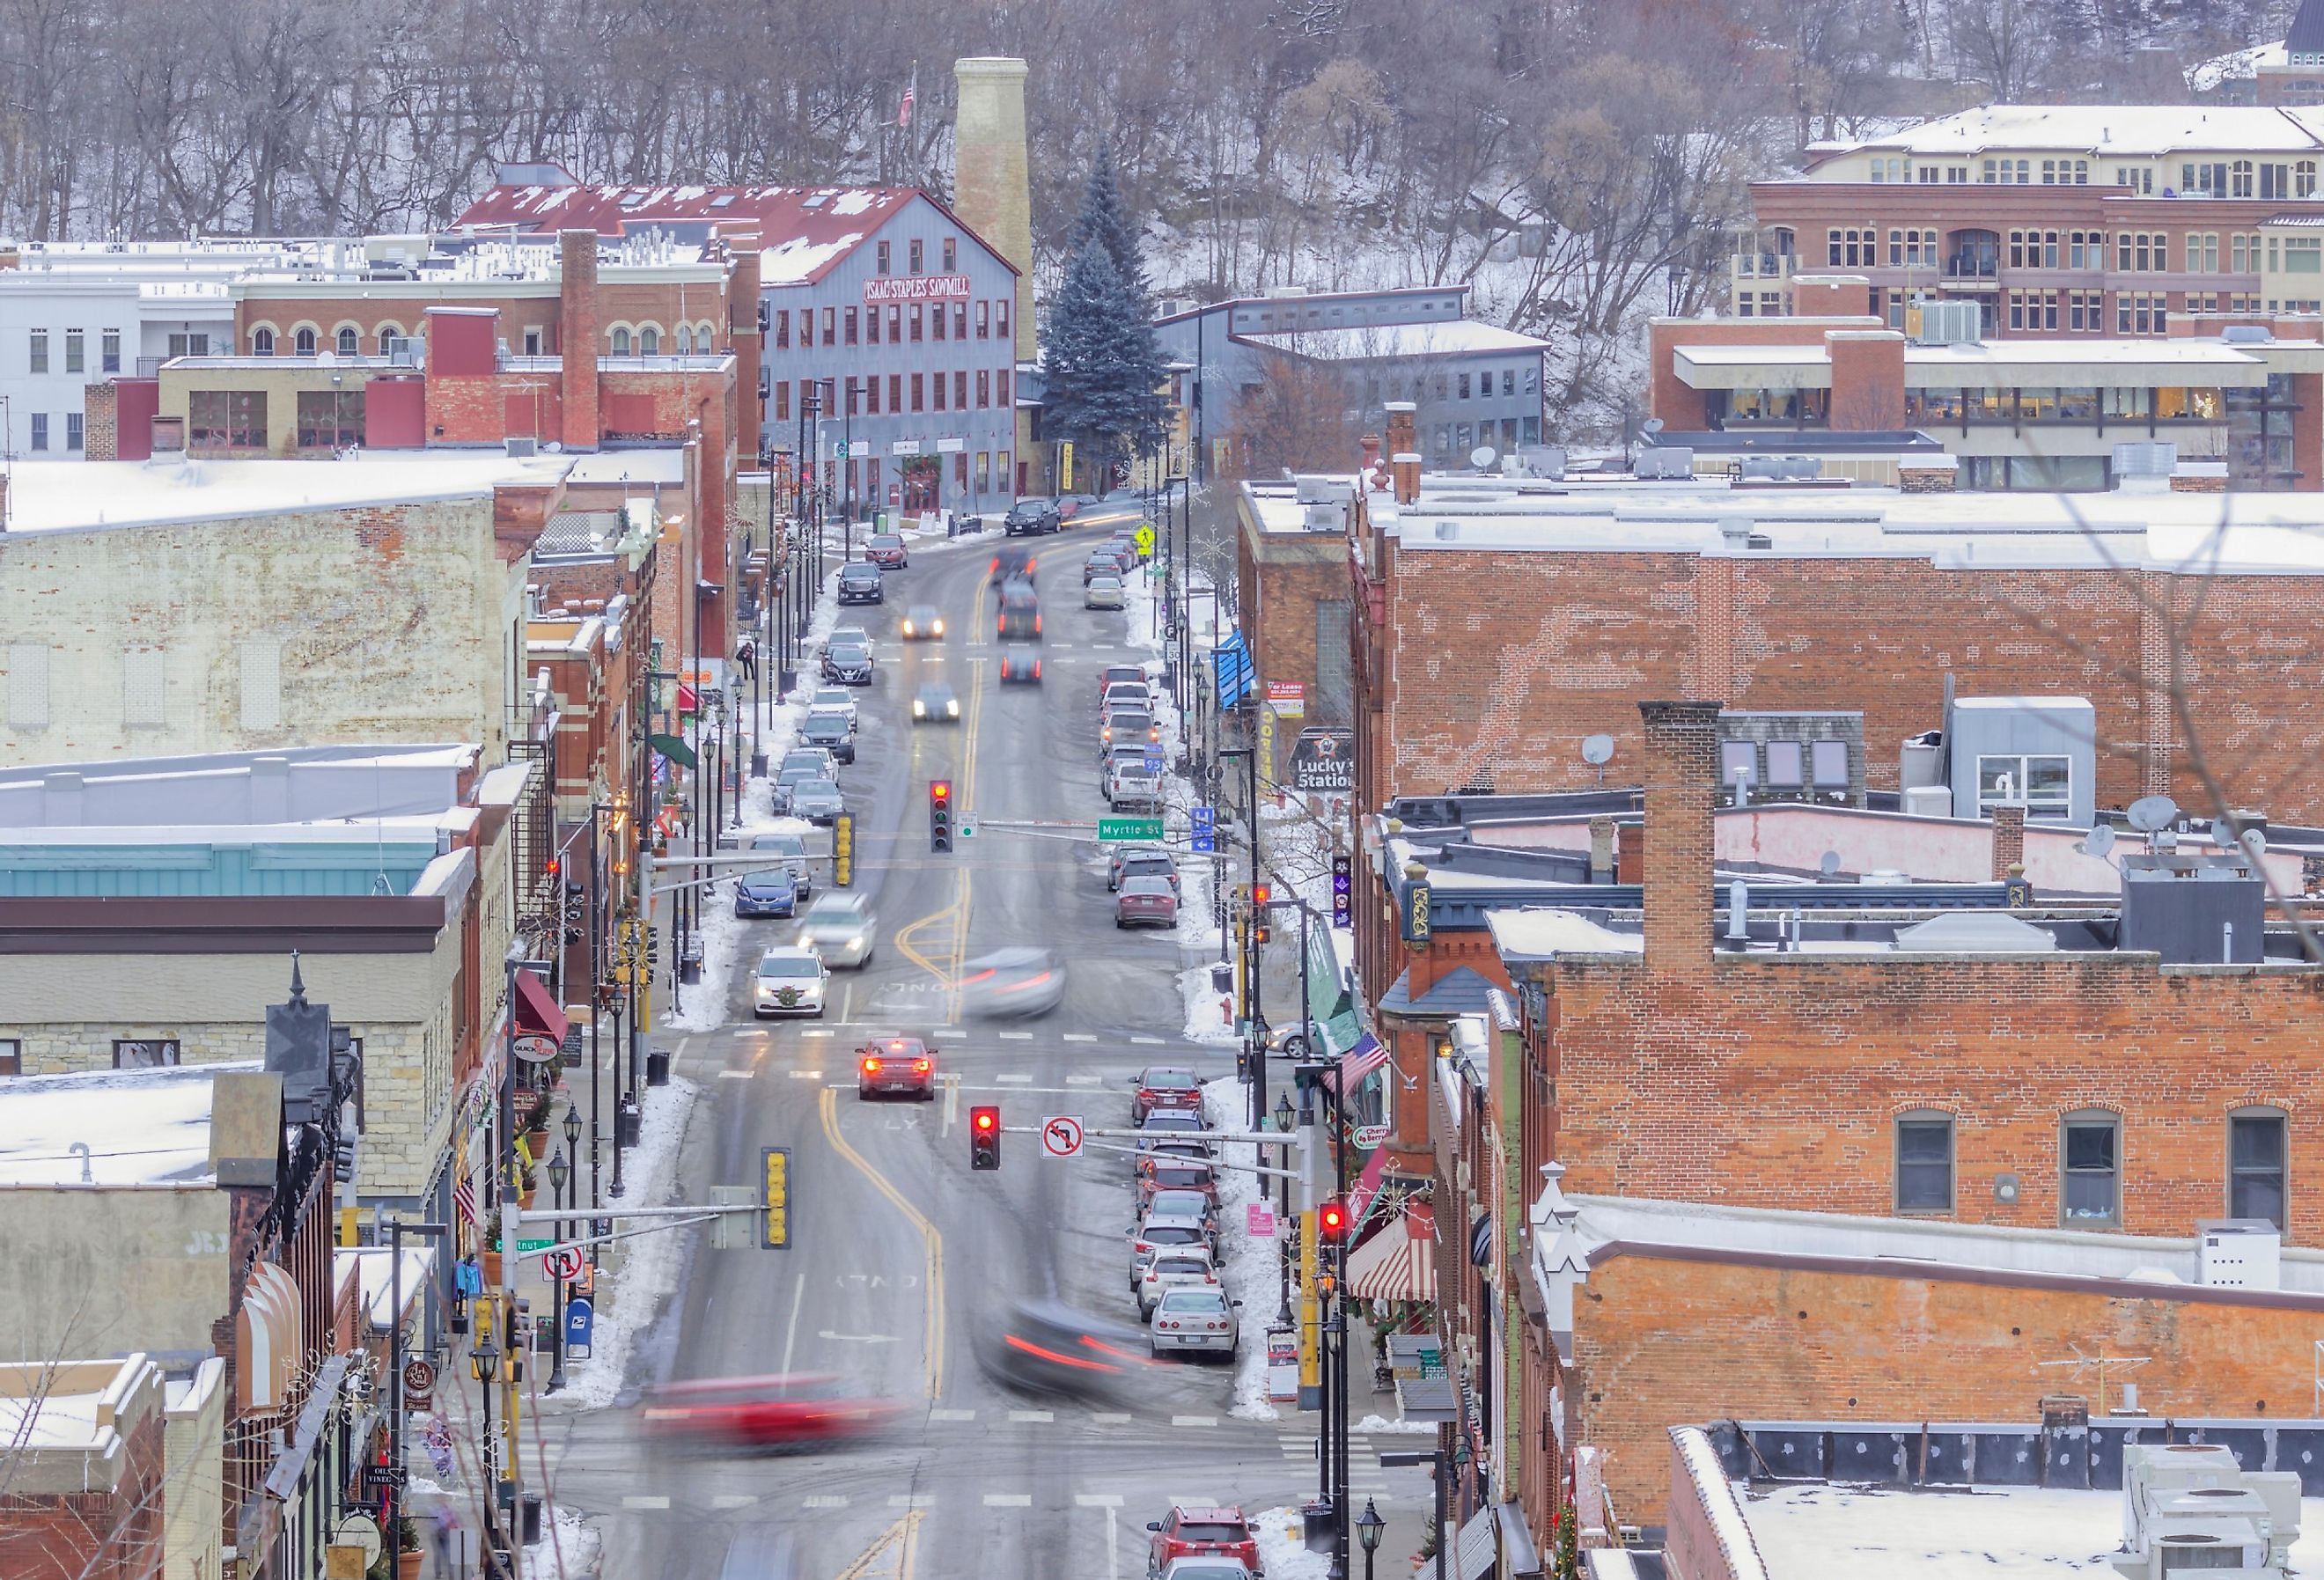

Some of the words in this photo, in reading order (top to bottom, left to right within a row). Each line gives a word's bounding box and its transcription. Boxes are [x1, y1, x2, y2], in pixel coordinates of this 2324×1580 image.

[866, 281, 889, 299] ISAAC
[891, 279, 926, 298] STAPLES
[929, 277, 968, 297] SAWMILL
[1146, 760, 1160, 769] 95
[1103, 826, 1141, 836] Myrtle
[1147, 826, 1159, 834] St
[496, 1241, 537, 1250] Ctnut
[408, 1363, 425, 1374] Art
